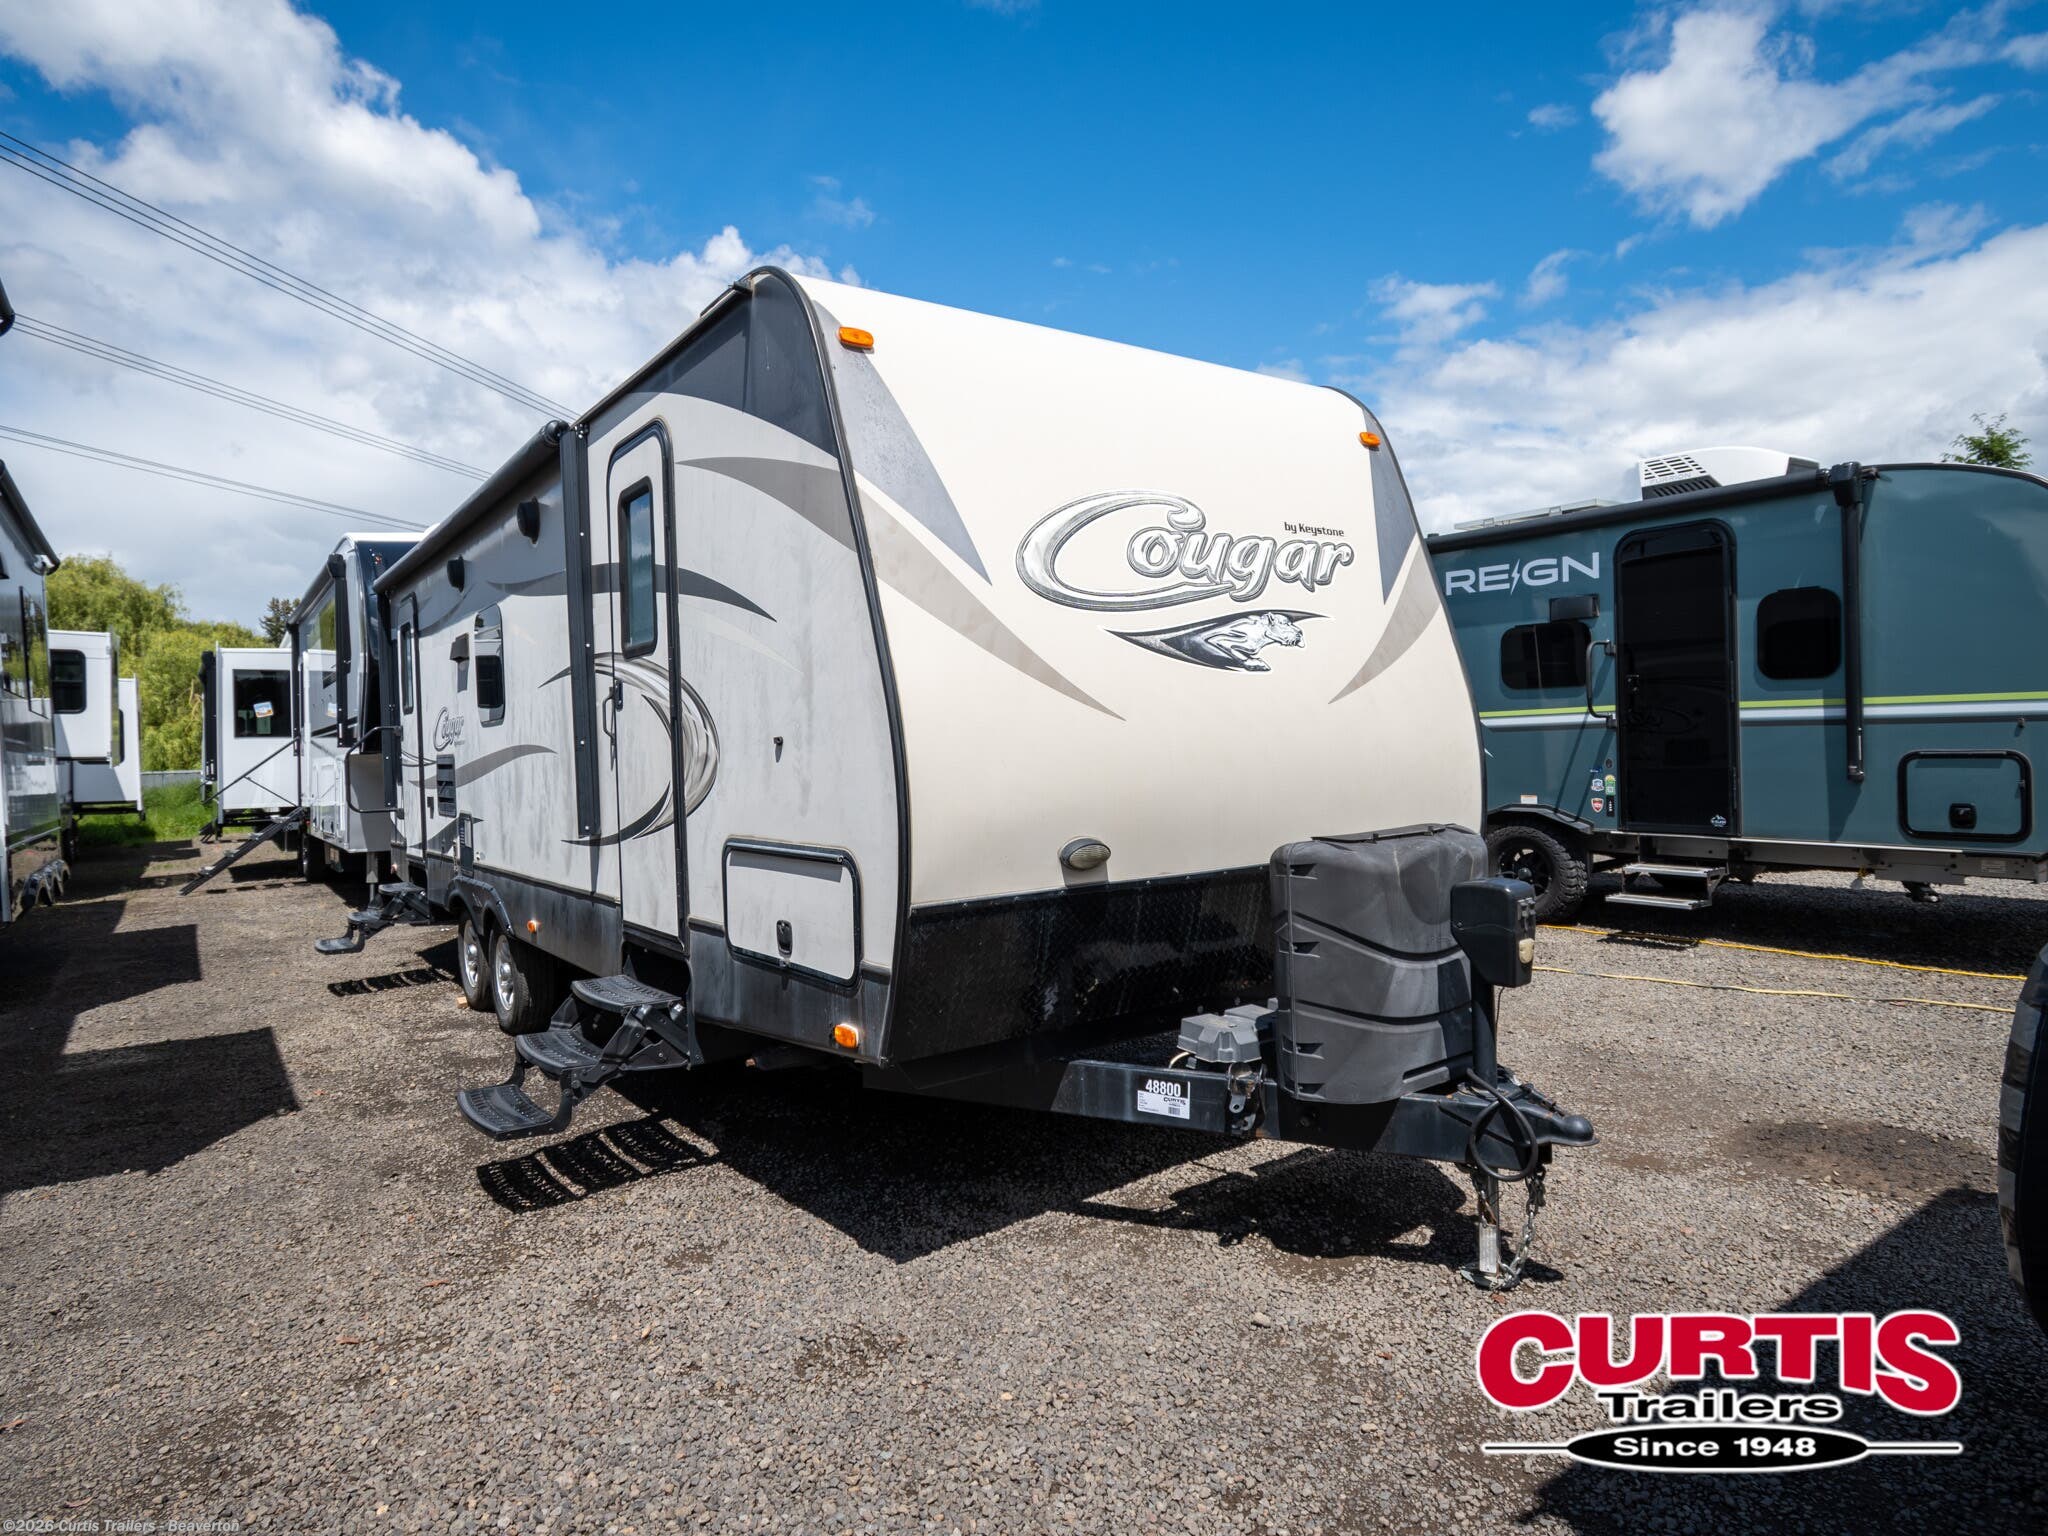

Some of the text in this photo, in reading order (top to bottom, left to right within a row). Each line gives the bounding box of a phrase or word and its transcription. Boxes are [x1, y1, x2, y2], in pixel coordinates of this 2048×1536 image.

[1284, 521, 1345, 537] by Keystone
[1016, 490, 1355, 612] Cougar
[1145, 1079, 1181, 1097] 48800
